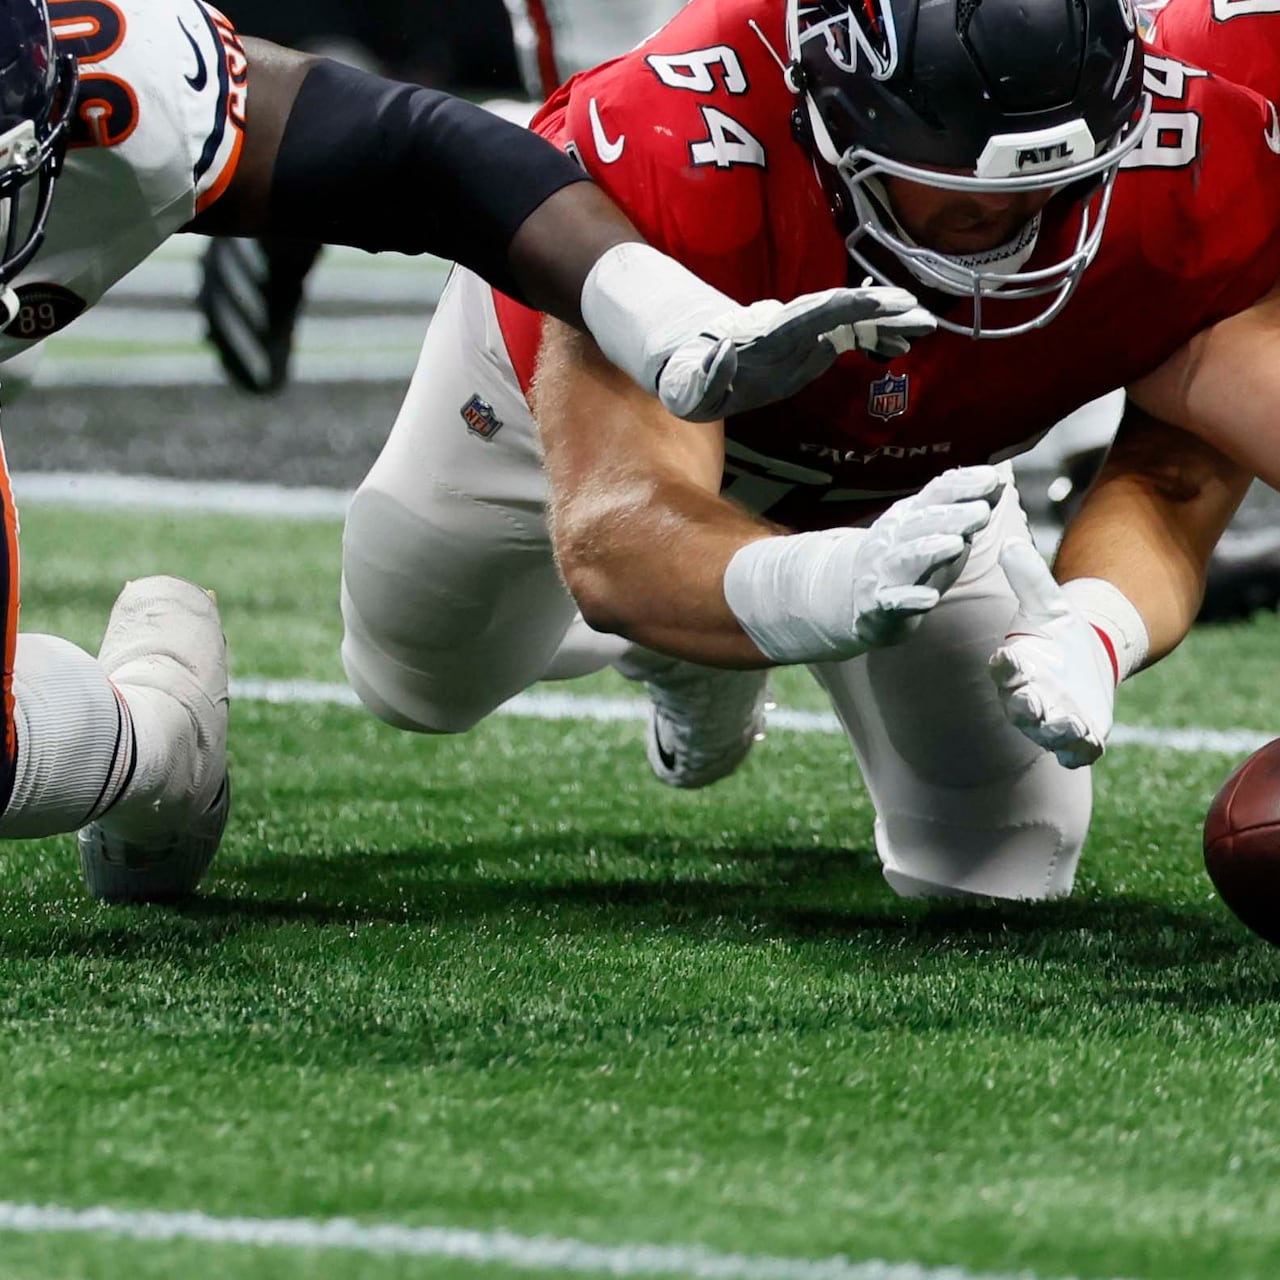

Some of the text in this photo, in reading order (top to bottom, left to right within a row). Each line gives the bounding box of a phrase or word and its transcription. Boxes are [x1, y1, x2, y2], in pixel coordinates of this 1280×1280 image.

[644, 43, 767, 168] 64
[1016, 141, 1075, 169] ATL
[20, 303, 56, 334] 89
[874, 393, 904, 414] NFL
